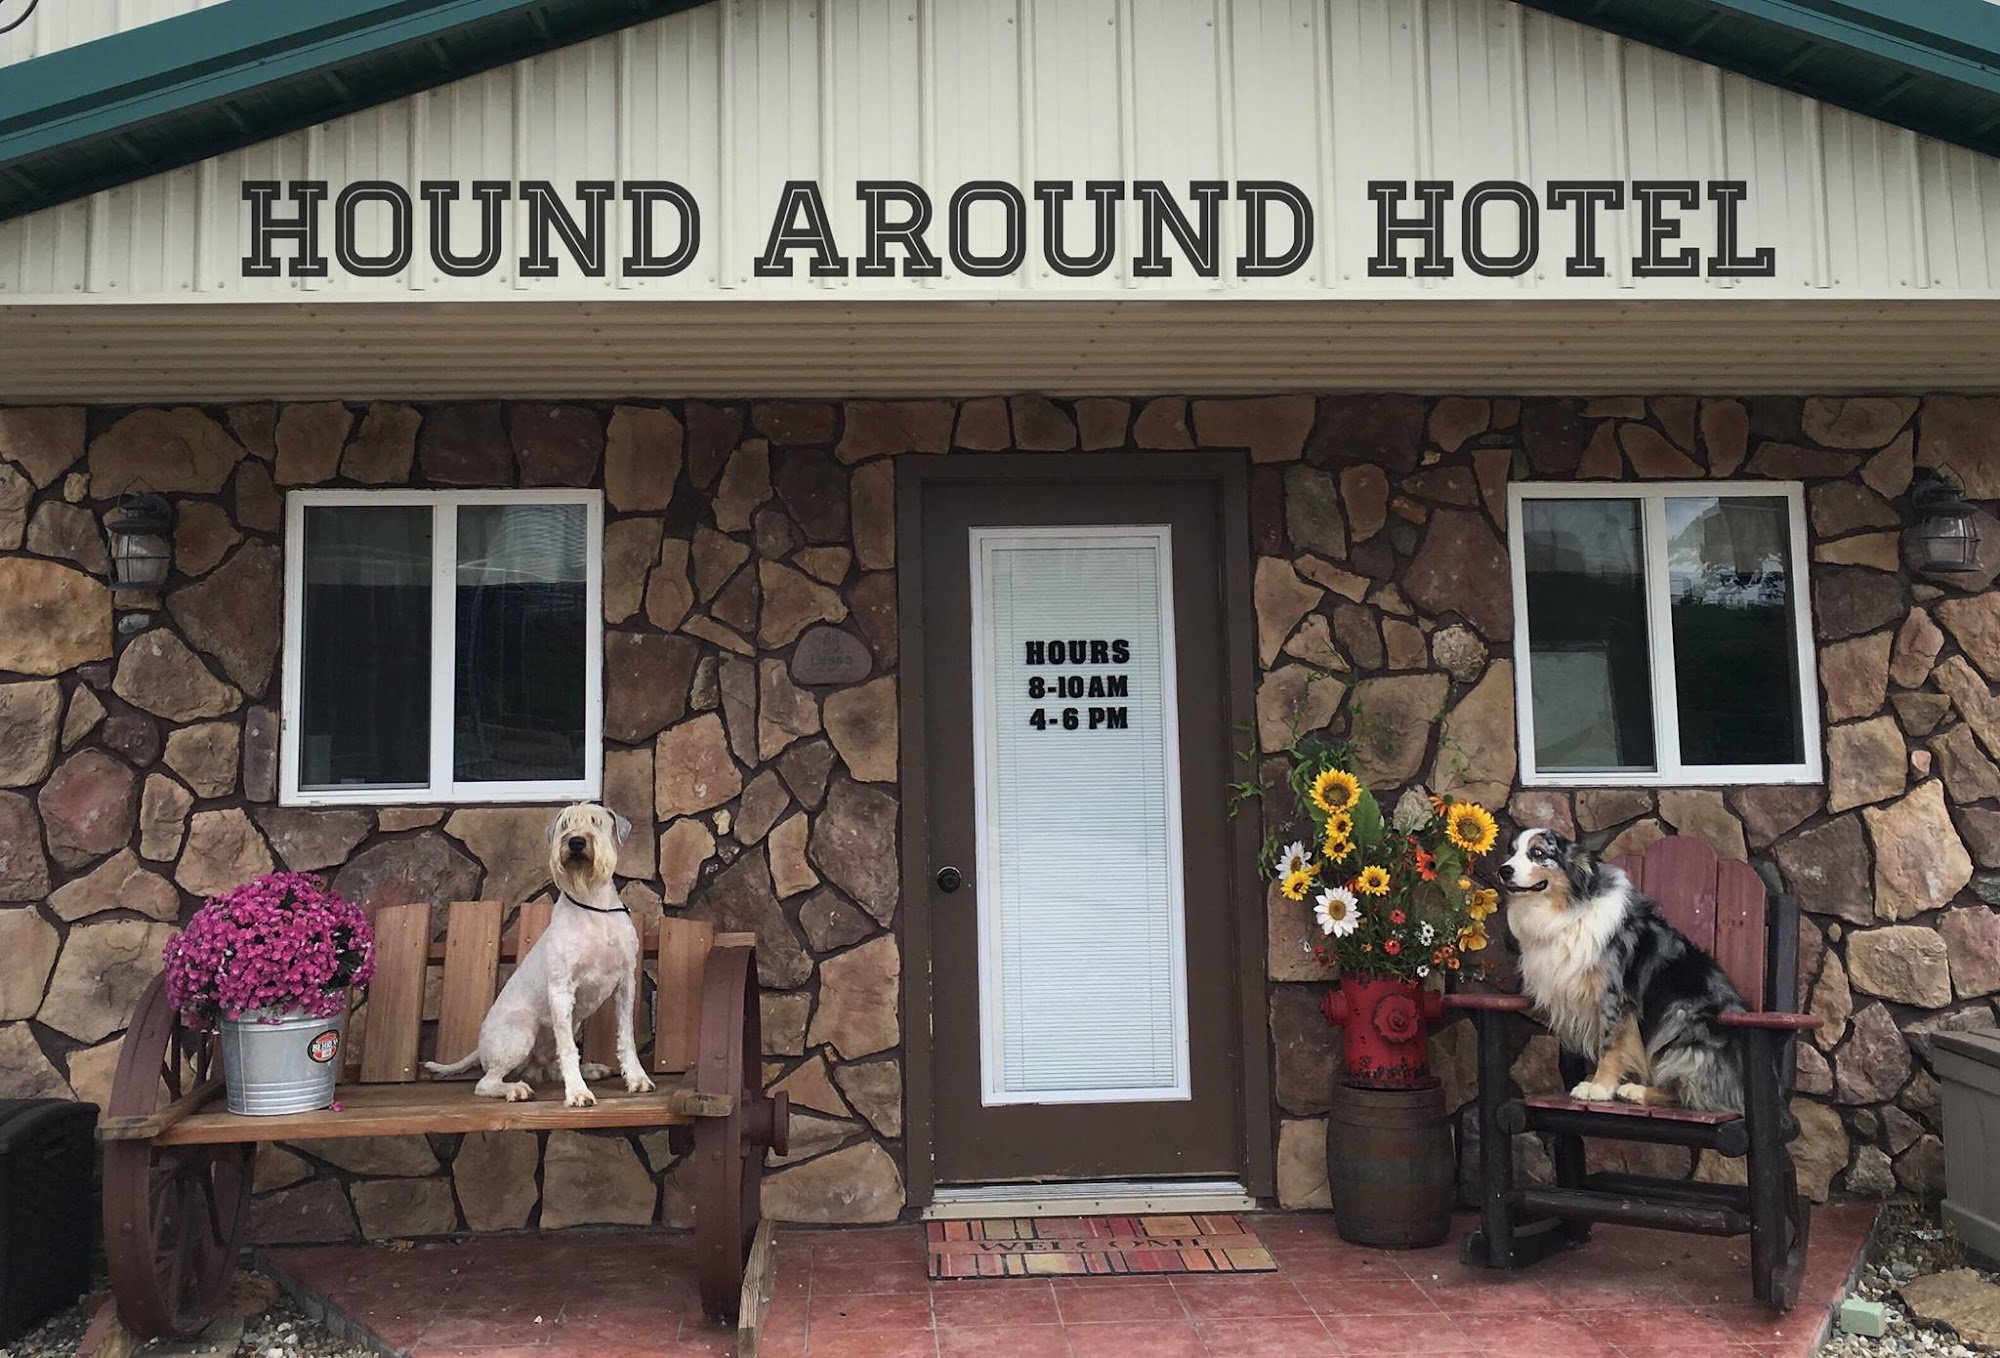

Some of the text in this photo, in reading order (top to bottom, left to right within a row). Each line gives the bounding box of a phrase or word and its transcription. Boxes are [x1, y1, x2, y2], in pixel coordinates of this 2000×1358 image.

[242, 181, 1775, 277] HOUND AROUND HOTEL
[1025, 639, 1130, 665] HOURS
[1029, 706, 1129, 730] 4-6 PM
